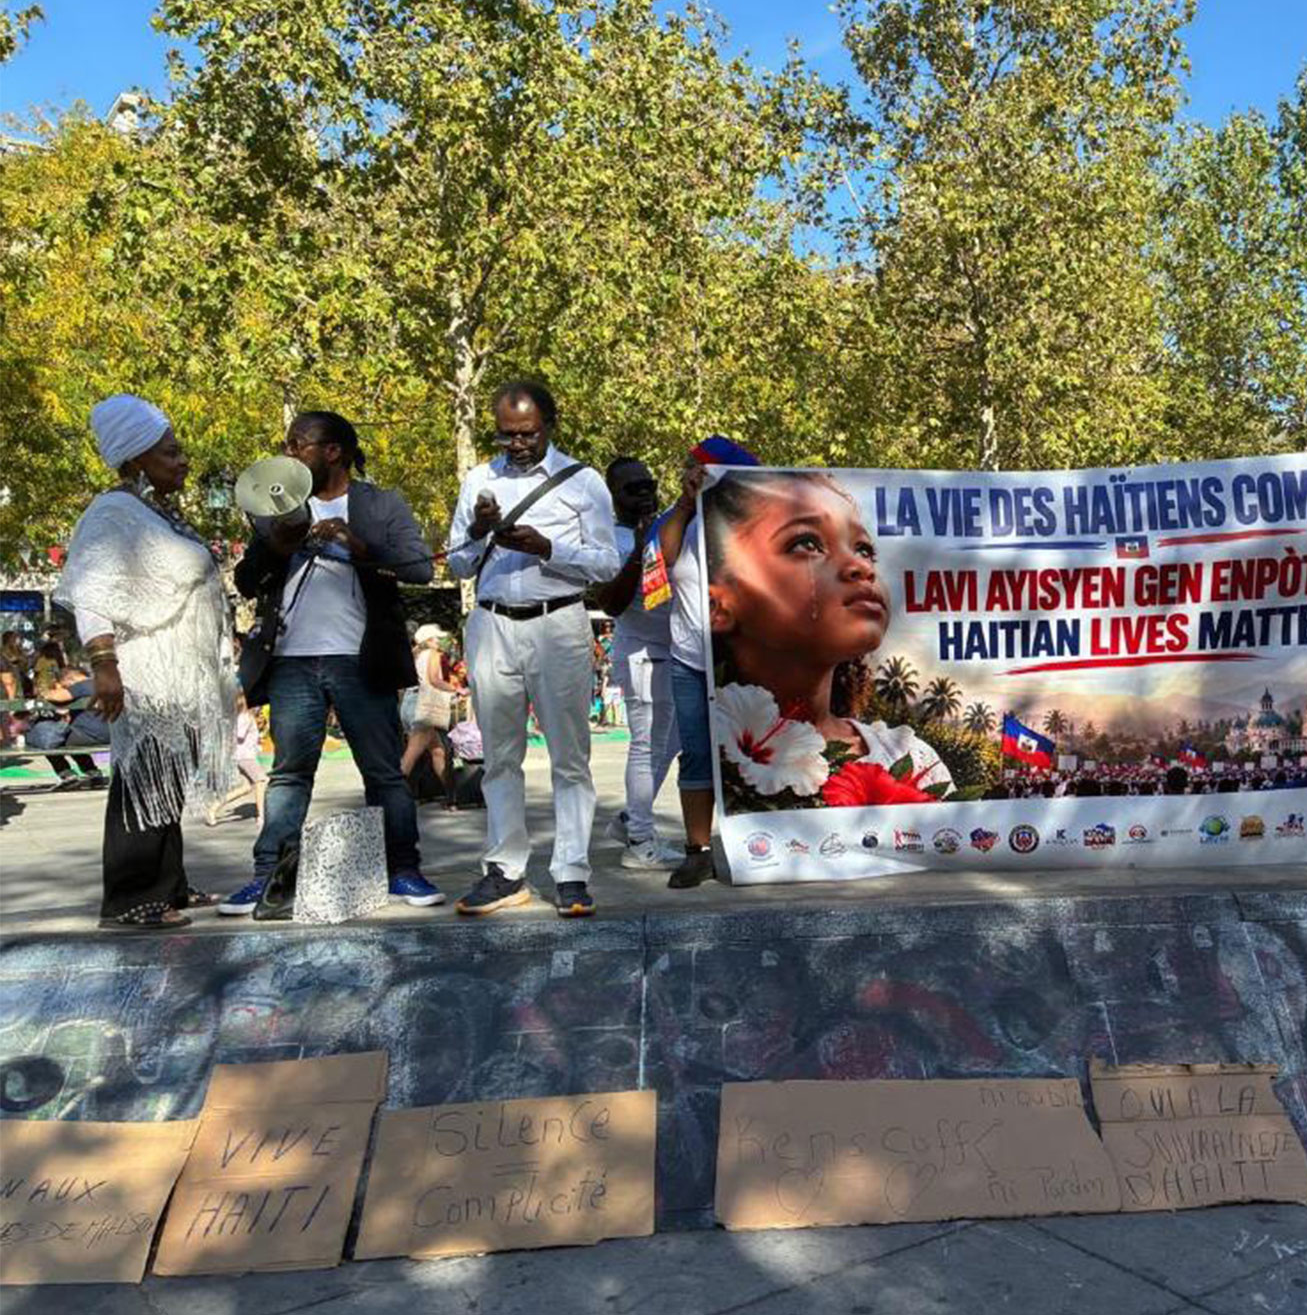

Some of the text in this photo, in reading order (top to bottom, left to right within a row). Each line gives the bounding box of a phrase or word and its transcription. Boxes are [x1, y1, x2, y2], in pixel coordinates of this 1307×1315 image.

[875, 486, 922, 537] LA
[925, 487, 983, 538] VIE
[988, 485, 1057, 538] DES
[1063, 473, 1227, 537] HAÏTIENS
[904, 569, 979, 613] LAVI
[985, 566, 1125, 613] AYISYEN
[1134, 561, 1204, 608] GEN
[938, 618, 1081, 661] HAITIAN
[1090, 612, 1190, 657] LIVES
[1217, 1083, 1258, 1115] LA
[219, 1125, 343, 1170] VIVE
[28, 1176, 107, 1203] AUX
[183, 1183, 332, 1244] HAITI
